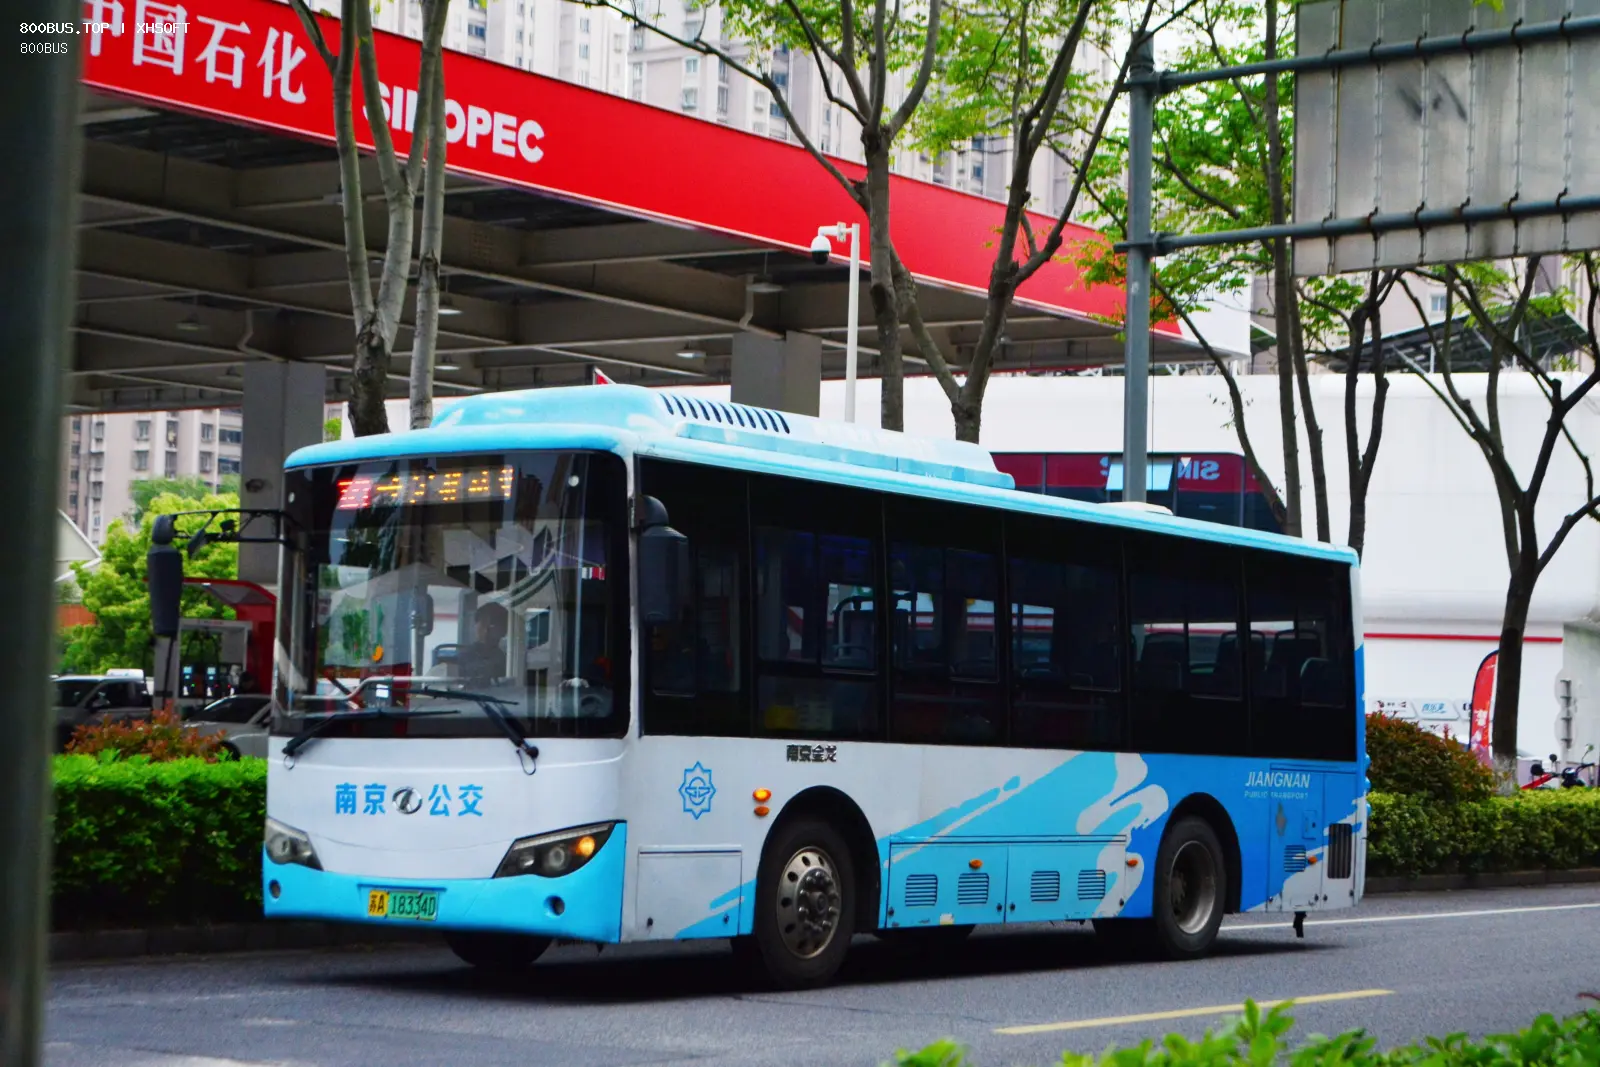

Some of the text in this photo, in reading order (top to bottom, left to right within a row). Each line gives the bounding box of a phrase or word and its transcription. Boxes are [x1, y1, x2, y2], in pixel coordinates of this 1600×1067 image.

[786, 744, 837, 762] 南京金龙
[1245, 771, 1311, 788] JIANGNAN
[335, 783, 484, 817] 南京 公交
